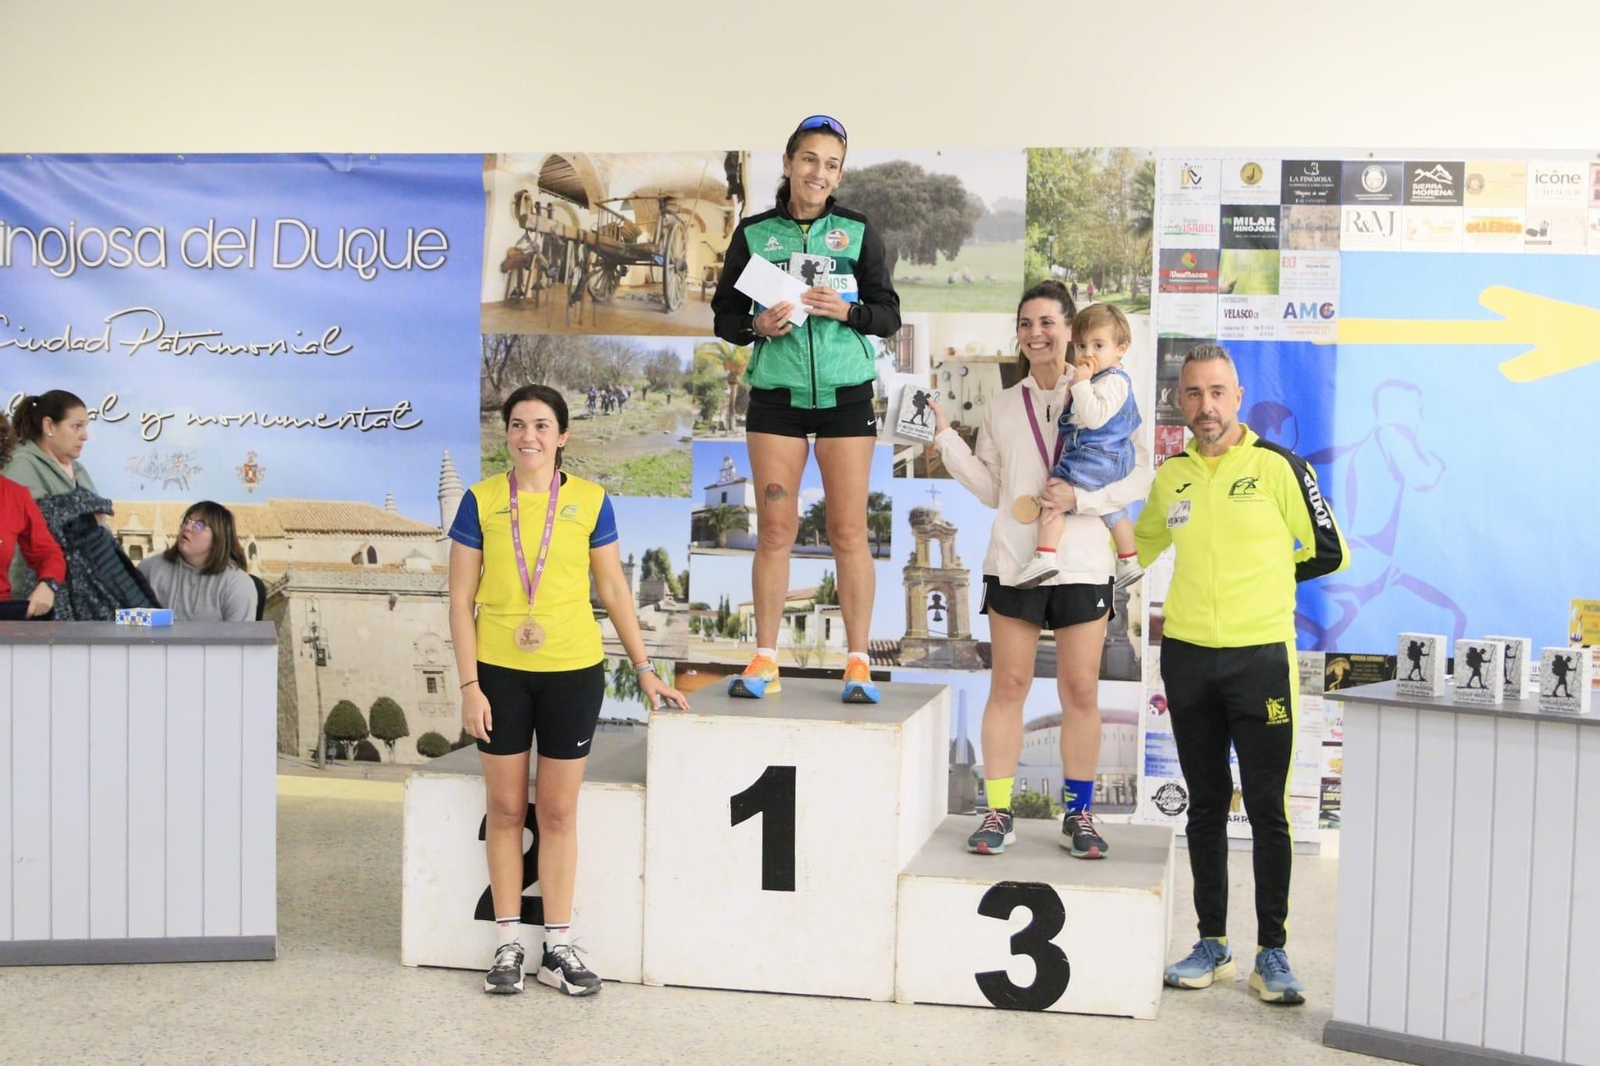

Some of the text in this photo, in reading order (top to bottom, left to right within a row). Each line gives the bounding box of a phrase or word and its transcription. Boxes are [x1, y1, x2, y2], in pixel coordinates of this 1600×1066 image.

[1289, 175, 1332, 183] LA FINOJOSA
[1535, 169, 1582, 185] icône
[1412, 189, 1454, 197] MORENA
[1233, 216, 1276, 226] MILAR
[1183, 223, 1216, 233] ISABEL
[1233, 225, 1276, 233] HINOJOSA
[0, 218, 448, 280] inojosa del Duque
[1224, 309, 1253, 319] VELASCO
[105, 307, 354, 357] Patrimonial
[140, 400, 424, 442] y monumental
[730, 765, 796, 892] 1
[974, 880, 1071, 1012] 3
